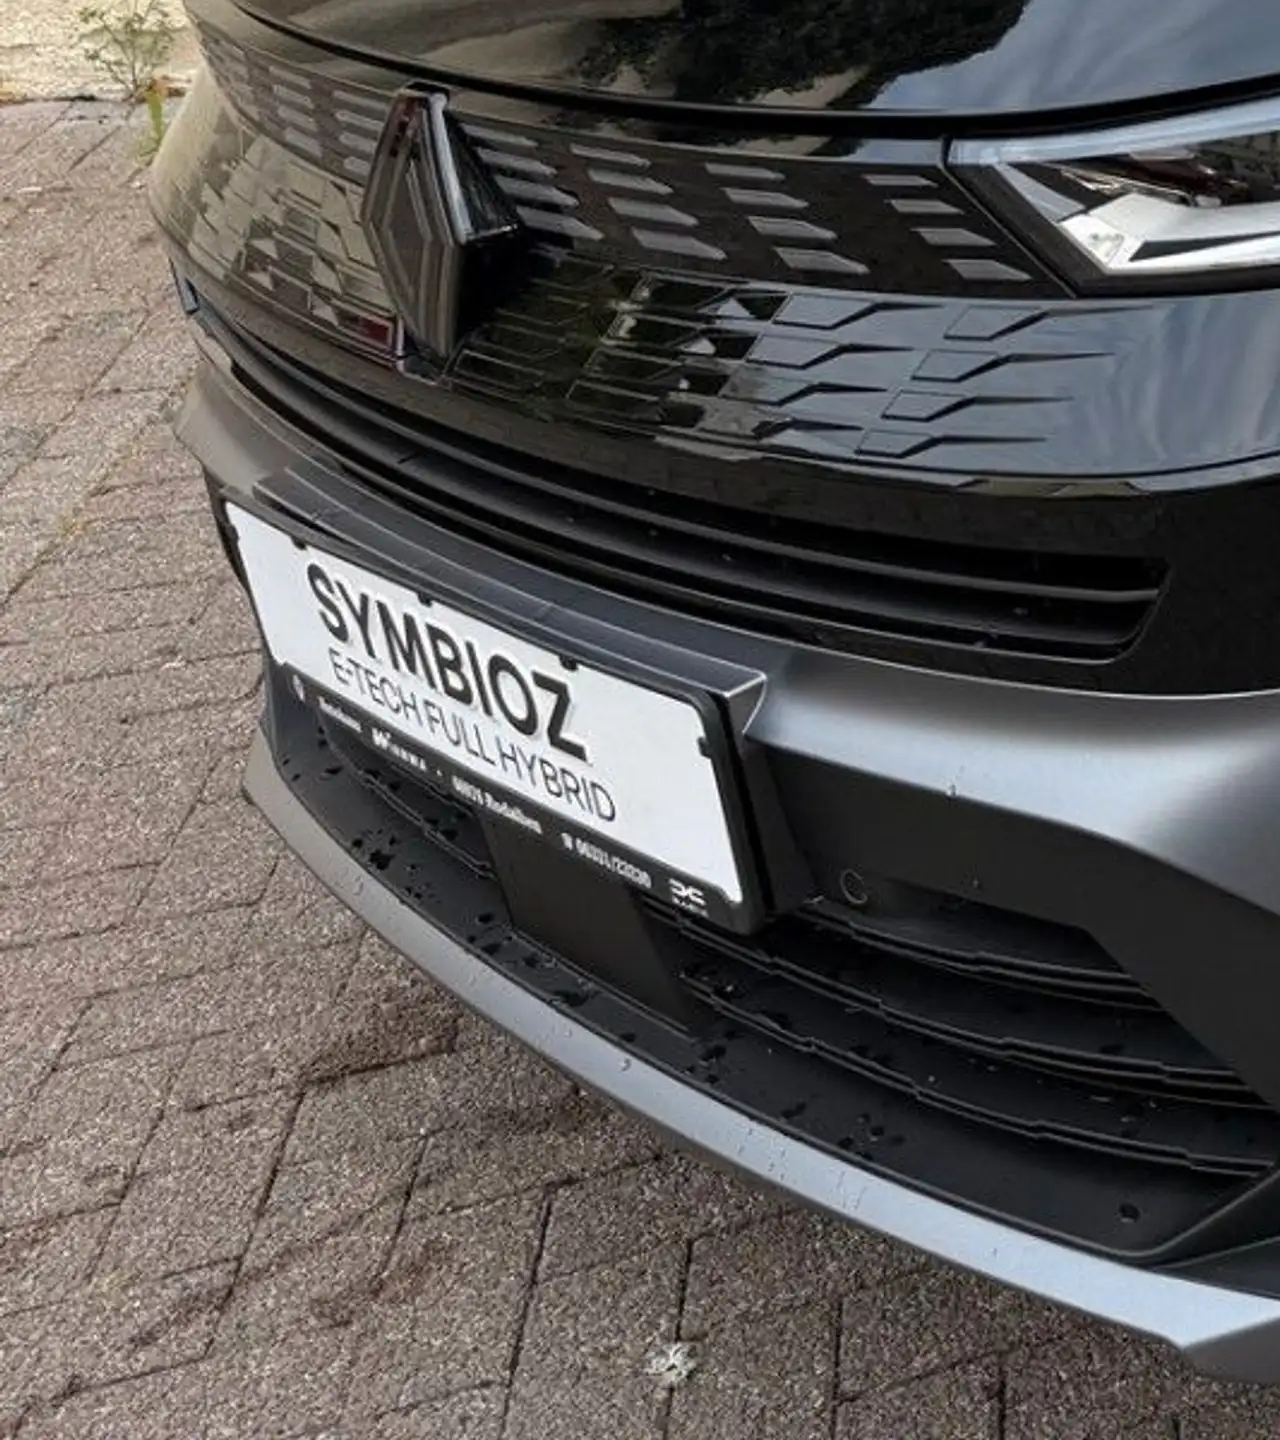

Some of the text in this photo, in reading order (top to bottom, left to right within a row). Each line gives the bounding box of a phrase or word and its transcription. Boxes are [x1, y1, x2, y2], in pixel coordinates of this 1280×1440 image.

[306, 562, 589, 763] SYMBIOZ
[328, 647, 422, 727] E-TECH
[423, 698, 496, 766] FULL
[496, 735, 616, 823] HYBRID
